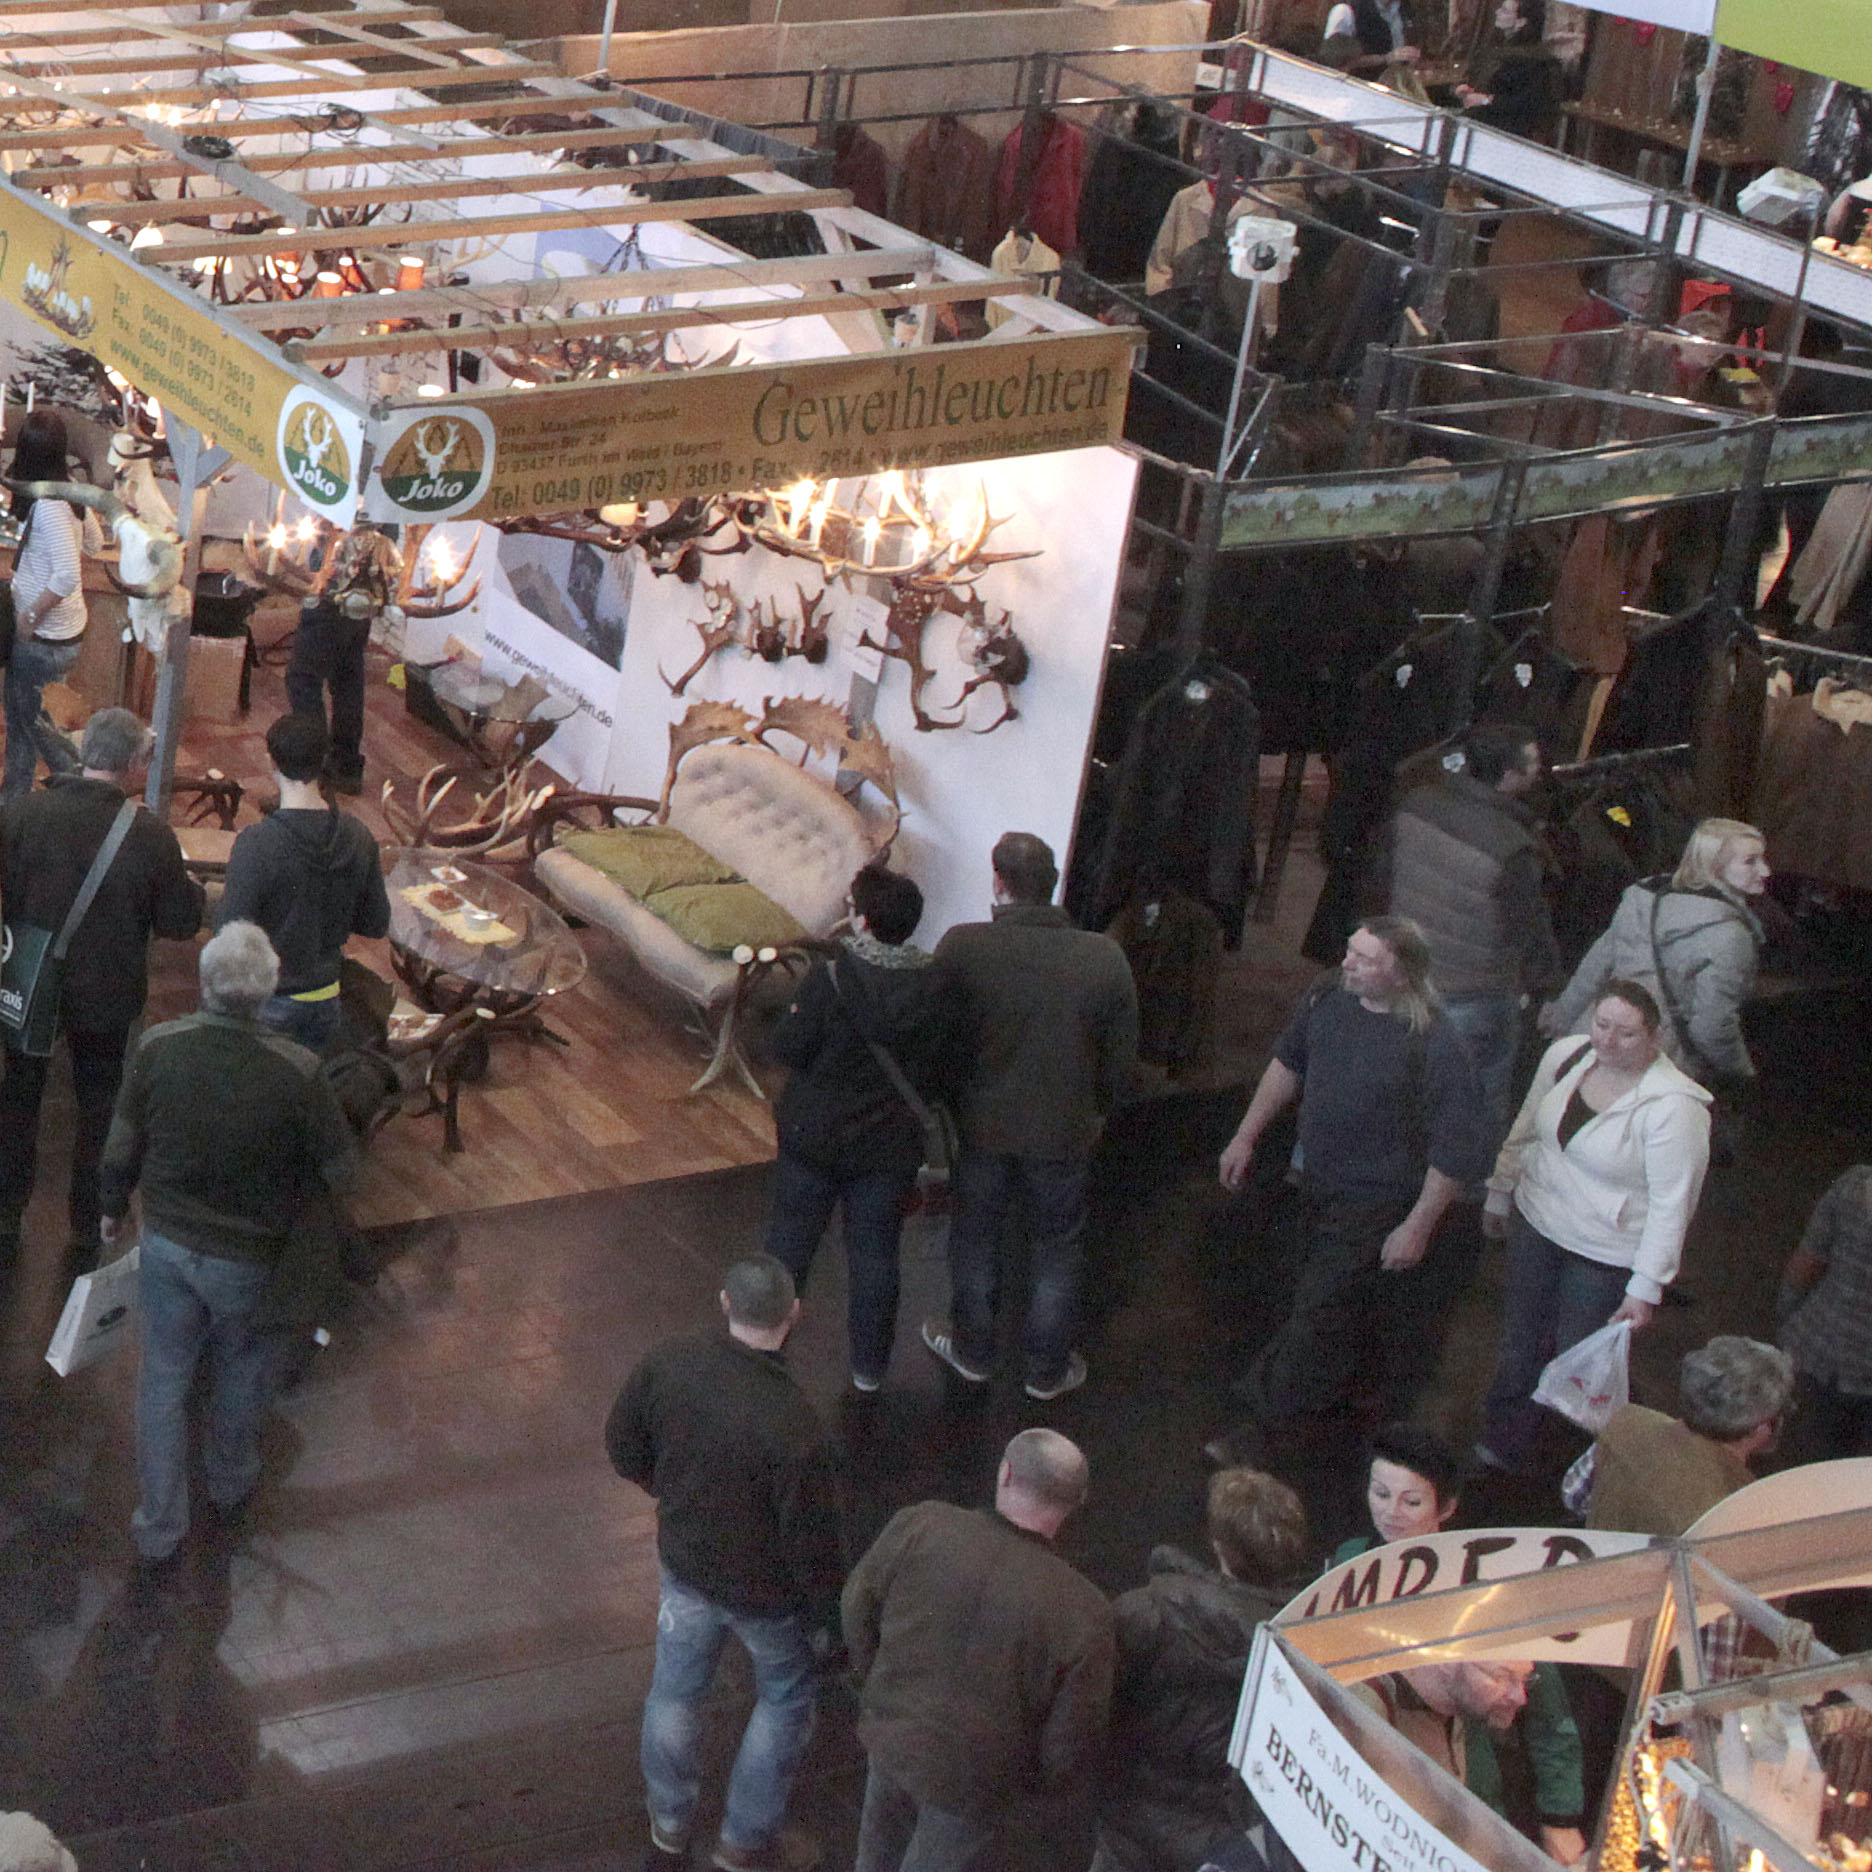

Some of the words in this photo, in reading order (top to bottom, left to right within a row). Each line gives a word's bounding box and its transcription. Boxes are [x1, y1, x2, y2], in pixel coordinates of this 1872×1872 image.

[752, 353, 1110, 447] Geweihleuchten
[294, 459, 336, 498] Joko
[397, 479, 463, 504] Joko
[532, 476, 581, 506] 0049
[588, 473, 613, 503] (0)
[619, 467, 668, 498] 9973
[686, 458, 733, 488] 3818
